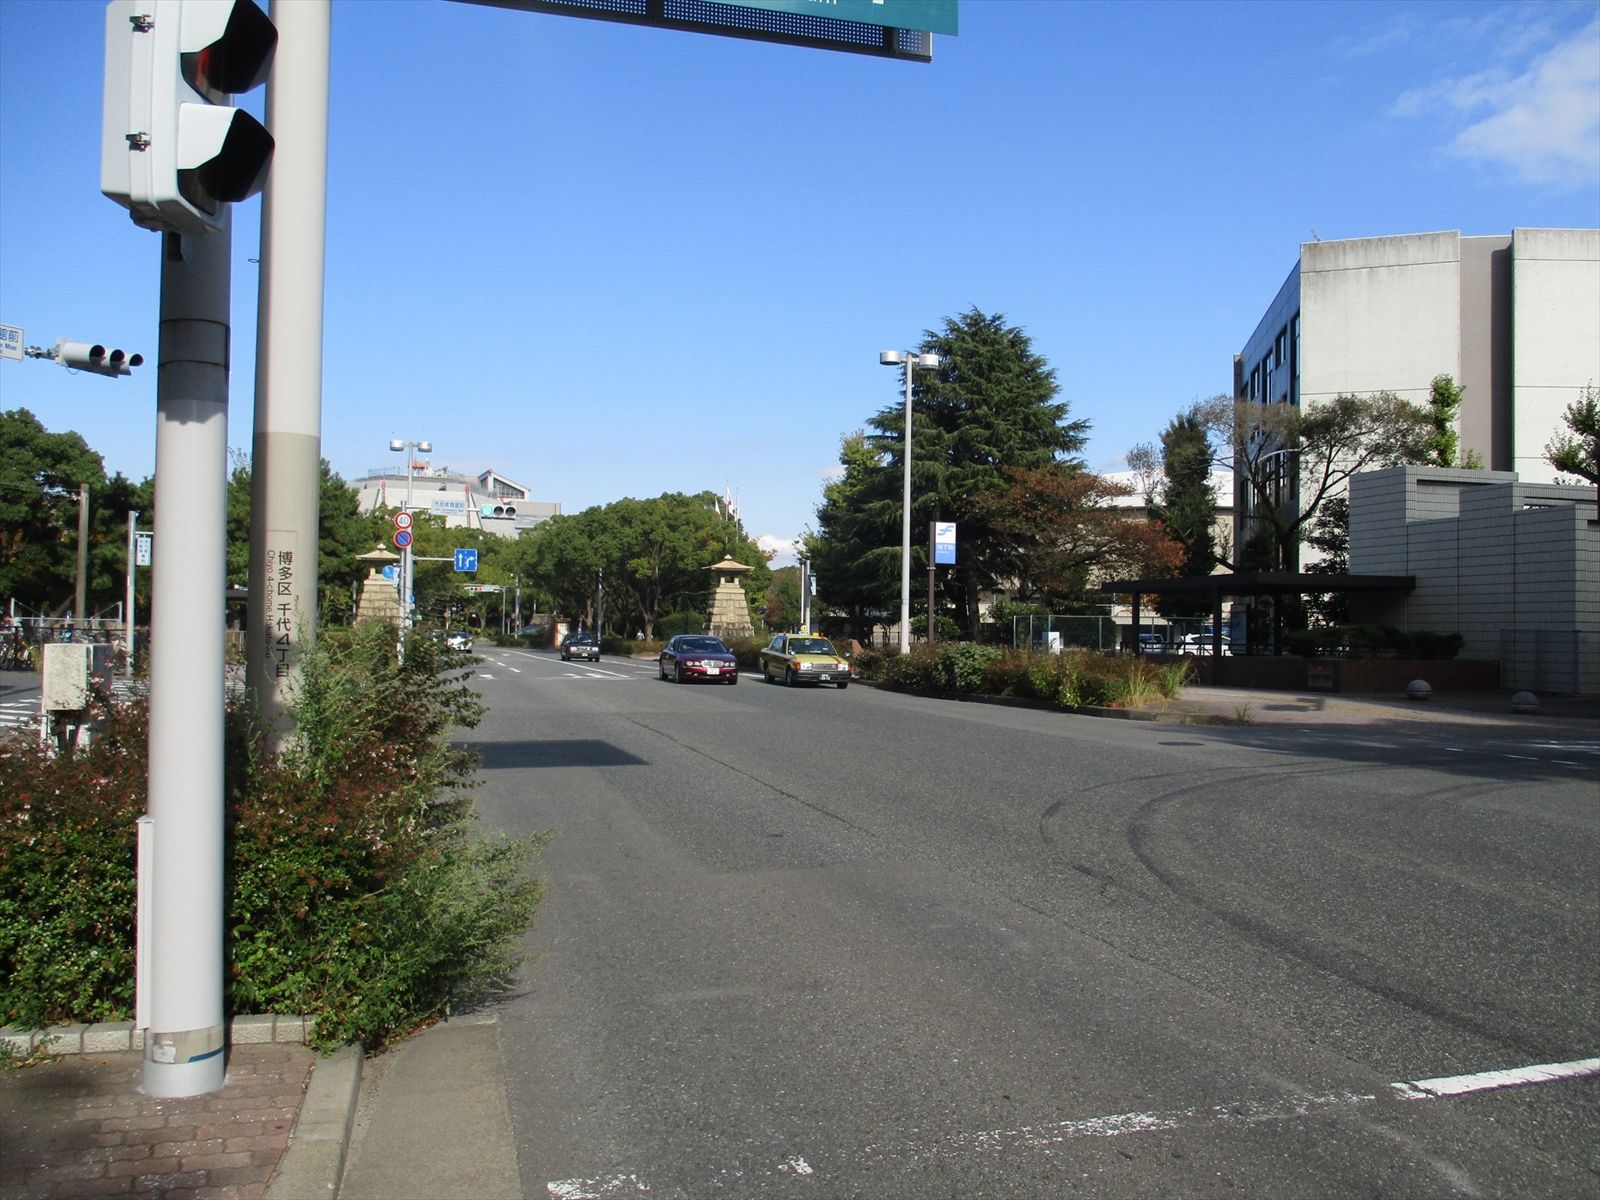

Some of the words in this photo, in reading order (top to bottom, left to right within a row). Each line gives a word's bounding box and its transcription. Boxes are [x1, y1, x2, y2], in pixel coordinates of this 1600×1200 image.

[399, 516, 408, 524] 40
[264, 550, 276, 574] Chiyo
[277, 550, 293, 596] 博多区
[276, 602, 293, 678] 千代4丁目
